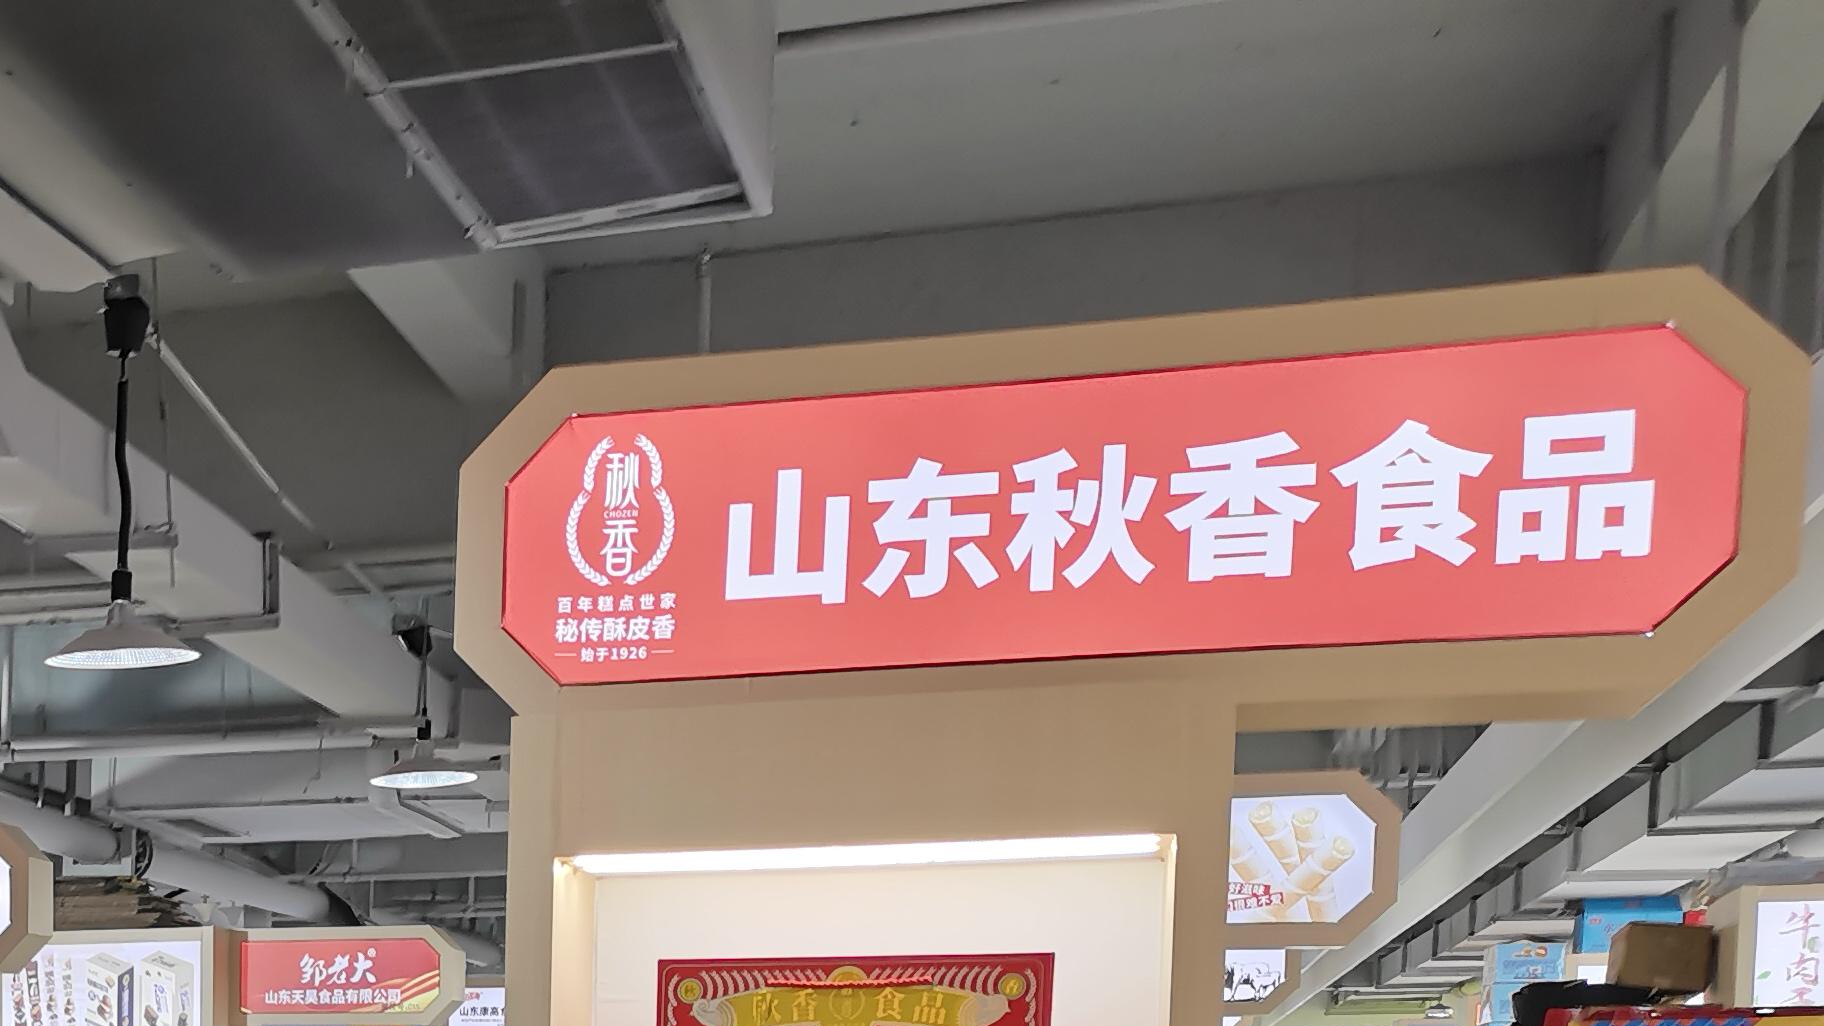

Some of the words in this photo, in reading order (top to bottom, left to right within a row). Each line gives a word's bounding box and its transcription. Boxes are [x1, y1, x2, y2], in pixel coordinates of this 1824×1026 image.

[723, 409, 1655, 603] 山东秋香食品
[557, 592, 676, 613] 百年糕点世家
[555, 614, 675, 643] 秘传酥皮香
[581, 647, 648, 662] 始于1926
[299, 951, 376, 986] 邹老大
